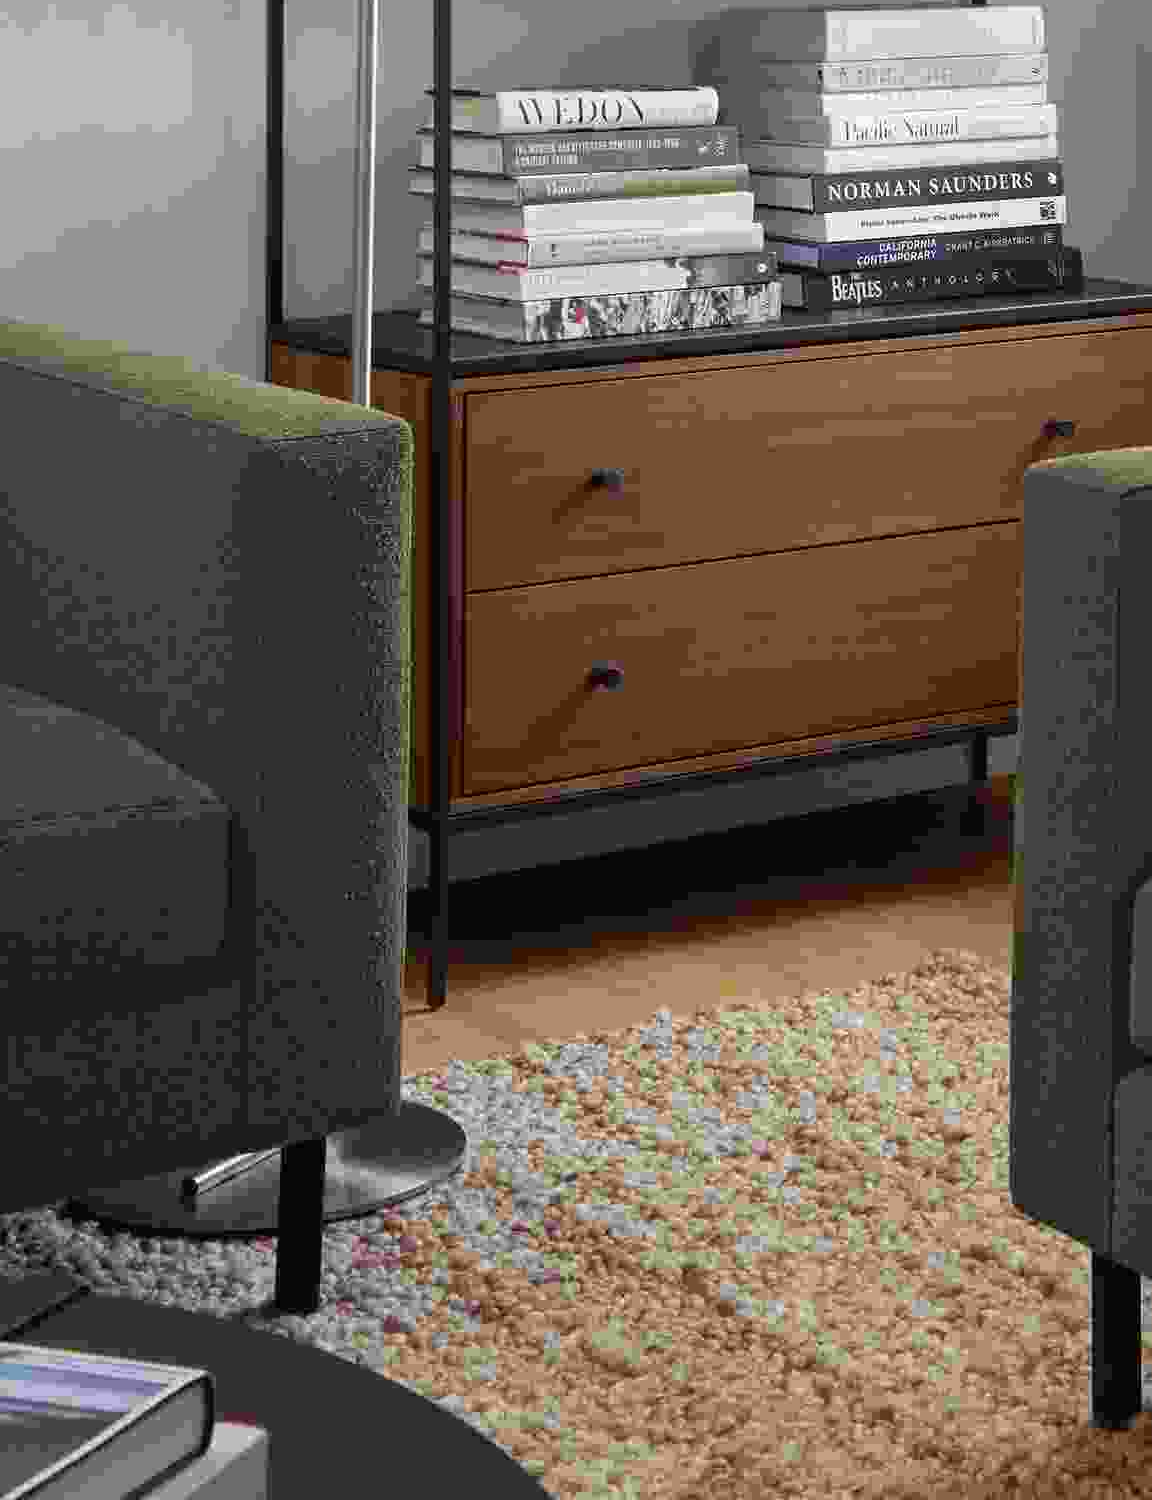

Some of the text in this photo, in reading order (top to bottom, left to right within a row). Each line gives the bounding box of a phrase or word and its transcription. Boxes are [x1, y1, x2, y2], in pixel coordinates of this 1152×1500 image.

[828, 170, 1034, 202] NORMAN SAUNDERS
[879, 238, 937, 253] CALIFORNIA
[856, 250, 937, 267] CONTEMPORARY
[831, 274, 884, 303] BEATLES
